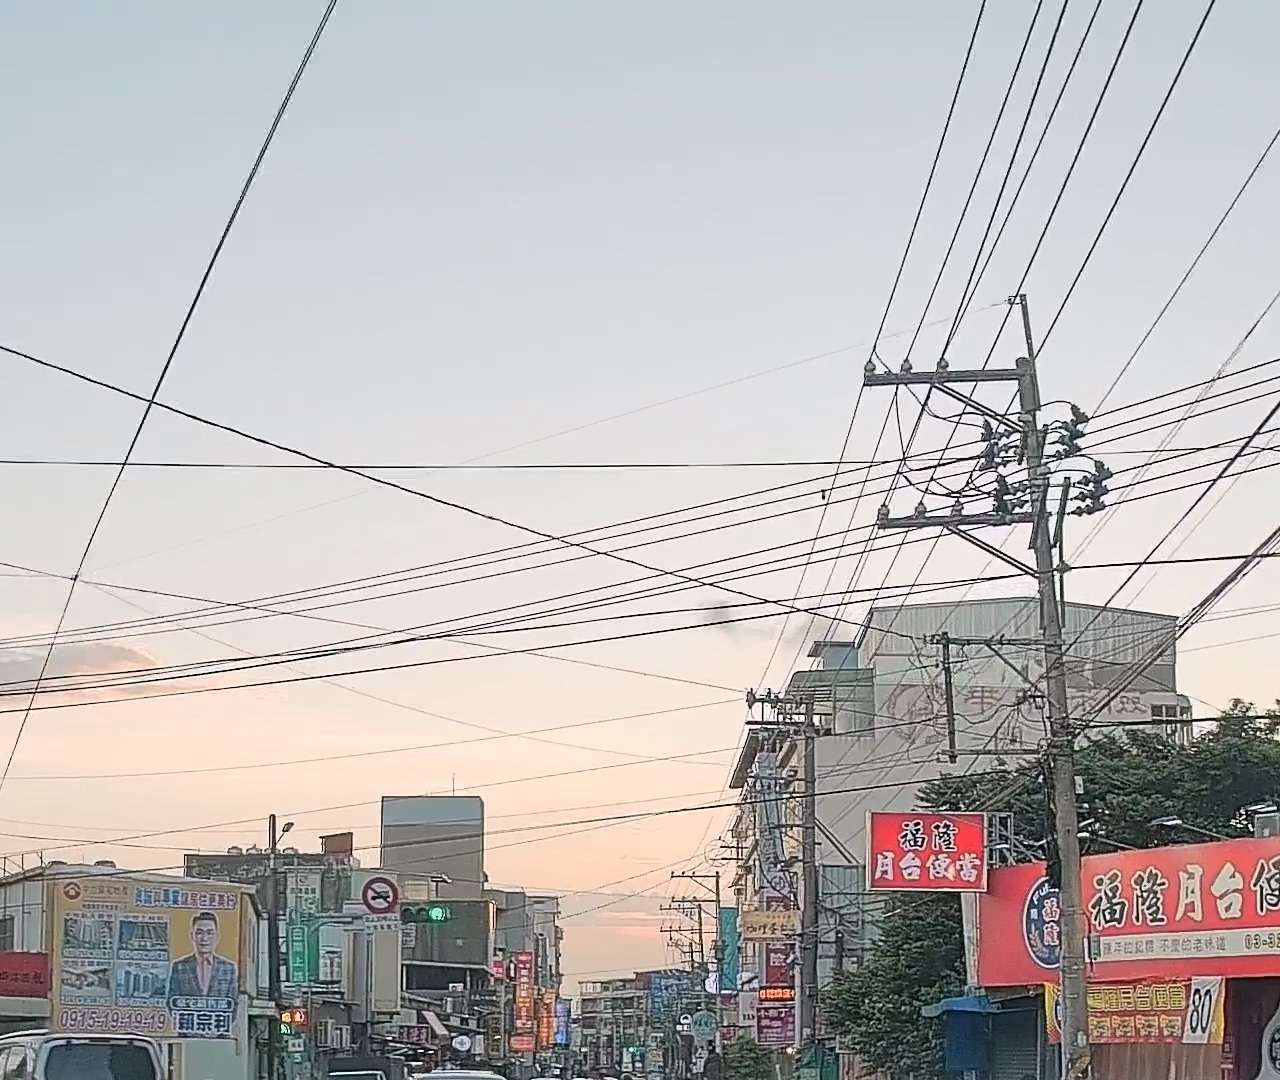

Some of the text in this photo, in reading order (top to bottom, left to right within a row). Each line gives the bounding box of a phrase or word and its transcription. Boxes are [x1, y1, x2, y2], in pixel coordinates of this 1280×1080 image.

[898, 820, 959, 852] 福隆
[874, 851, 981, 882] 月台便當
[59, 1008, 168, 1032] 0915-19-19-19
[1087, 984, 1186, 1011] 福隆月台便當
[1190, 988, 1213, 1034] 80
